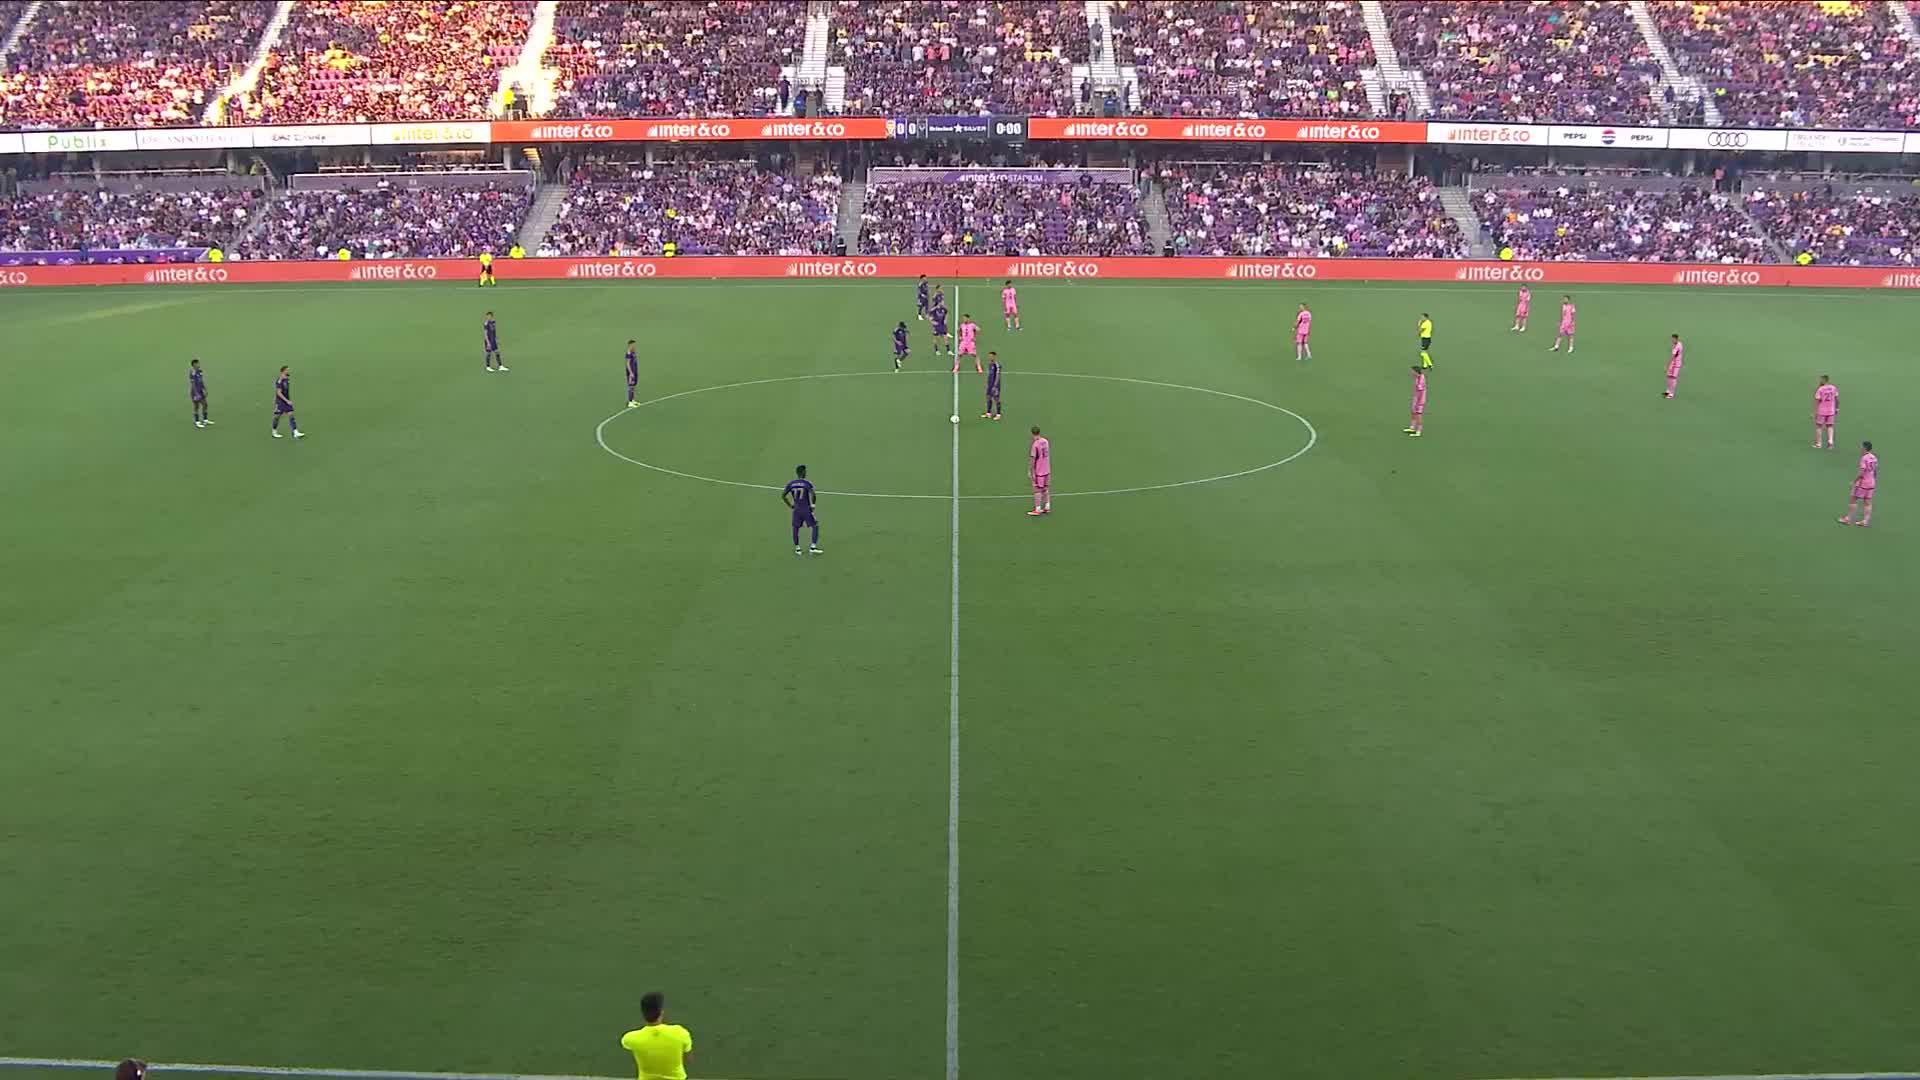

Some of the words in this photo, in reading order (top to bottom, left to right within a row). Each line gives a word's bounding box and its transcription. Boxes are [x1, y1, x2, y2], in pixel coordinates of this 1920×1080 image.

[542, 124, 614, 139] inter&co
[657, 123, 730, 138] inter&co
[772, 122, 845, 137] inter&co
[996, 122, 1021, 135] 0:00
[1075, 122, 1149, 137] inter&co
[1194, 123, 1266, 138] inter&co
[1309, 124, 1380, 140] inter&co
[1563, 132, 1588, 140] PEPSI
[155, 267, 228, 282] inter&co
[360, 263, 437, 280] inter&co
[580, 261, 657, 277] inter&co
[799, 261, 877, 277] inter&co
[1020, 261, 1099, 277] inter&co
[1238, 262, 1316, 278] inter&co
[1468, 264, 1544, 281] inter&co
[1685, 268, 1760, 285] inter&co
